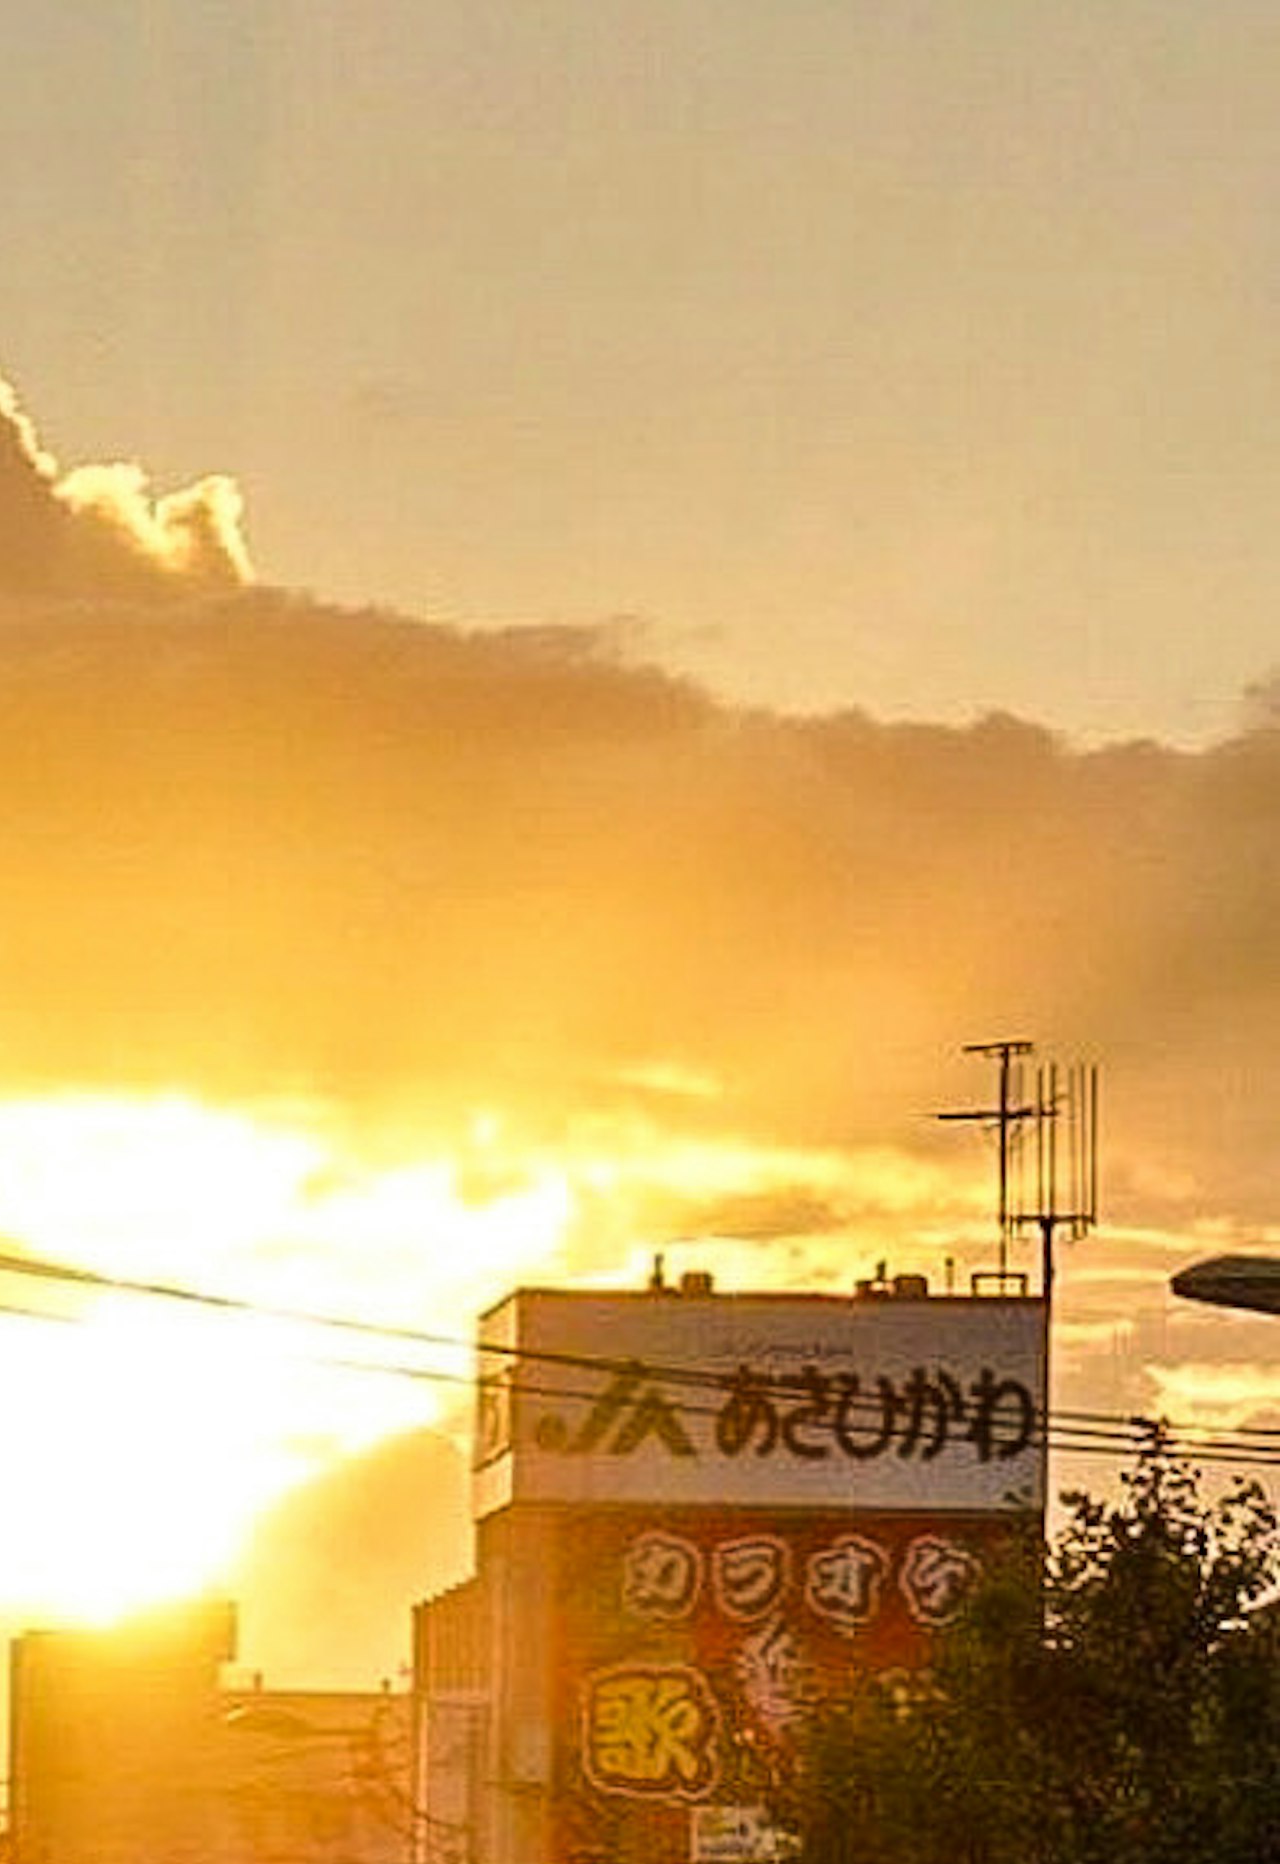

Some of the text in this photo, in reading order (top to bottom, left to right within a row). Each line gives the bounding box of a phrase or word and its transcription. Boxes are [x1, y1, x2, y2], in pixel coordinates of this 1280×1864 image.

[715, 1365, 1034, 1461] あさひかわ
[628, 1538, 974, 1619] カラオケ
